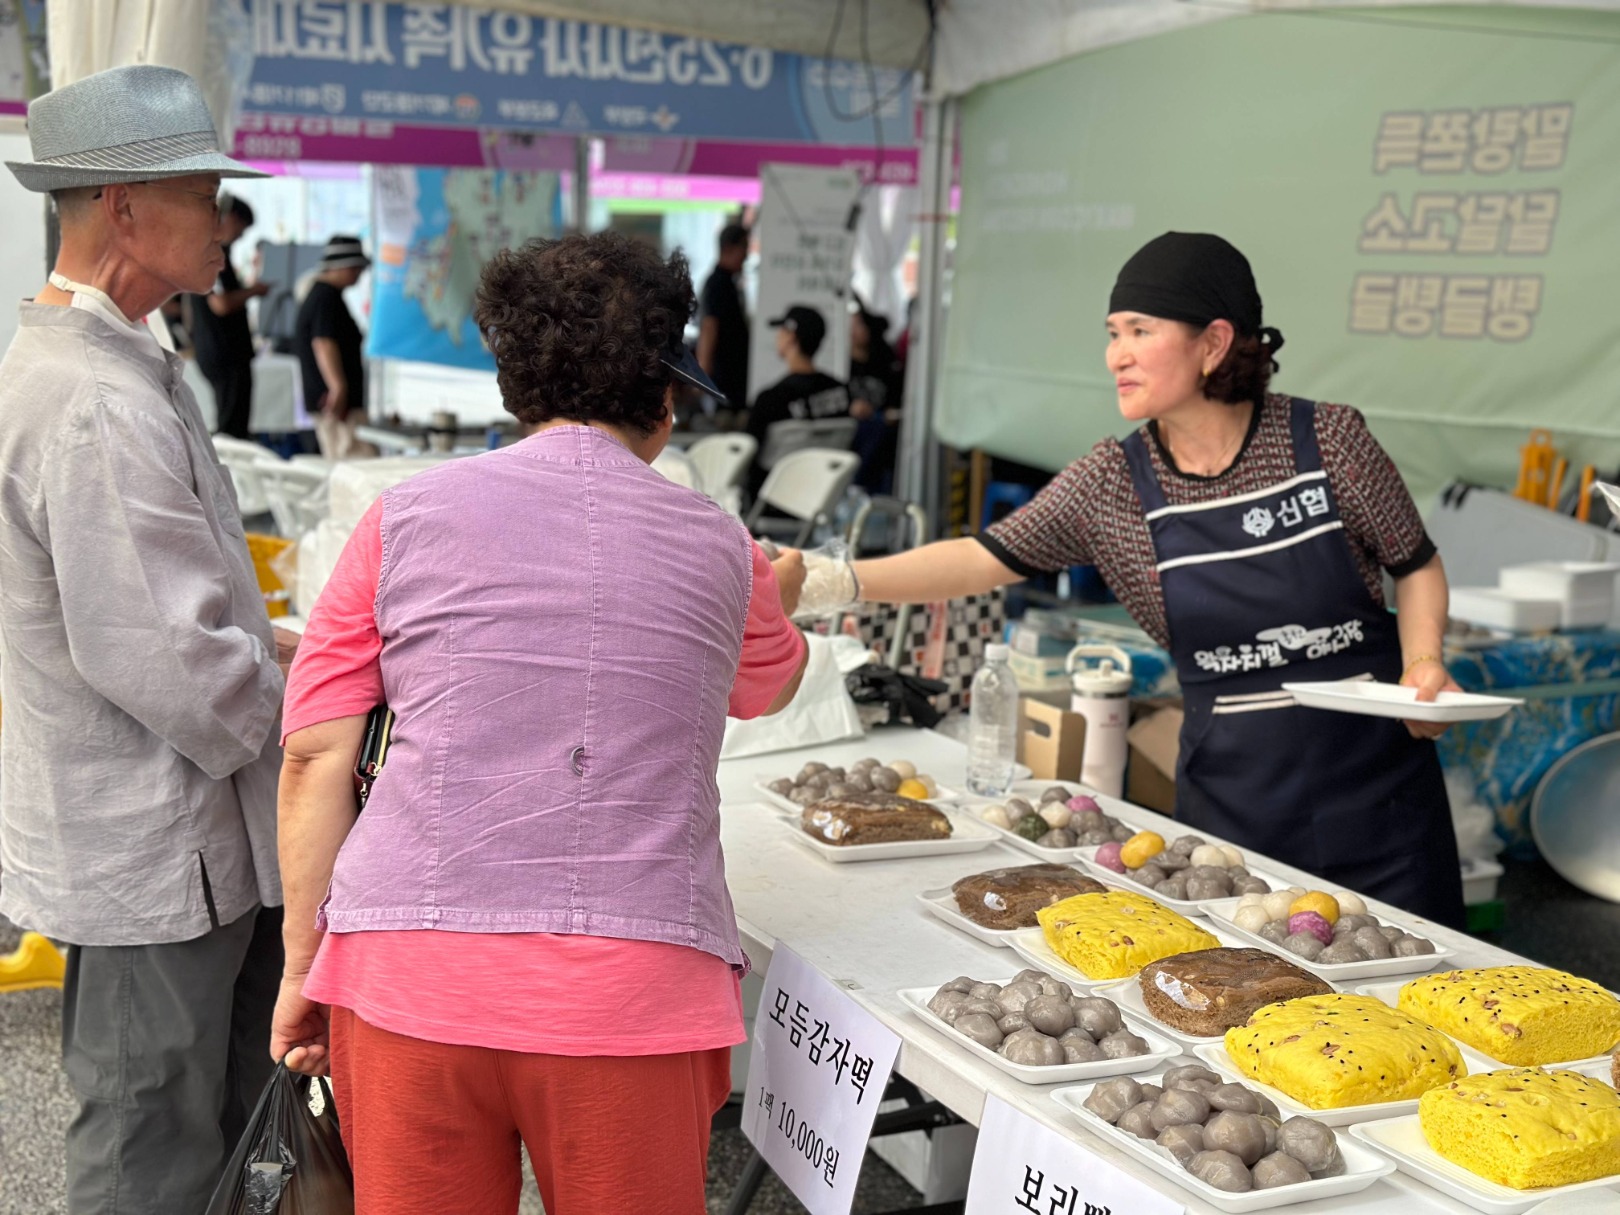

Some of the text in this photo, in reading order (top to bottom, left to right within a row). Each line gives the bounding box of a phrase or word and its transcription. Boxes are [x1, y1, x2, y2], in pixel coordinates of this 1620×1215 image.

[1277, 485, 1329, 528] 신협
[769, 987, 874, 1105] 모듬감자떡
[778, 1101, 840, 1188] 10,000원
[1014, 1164, 1112, 1215] 보리
